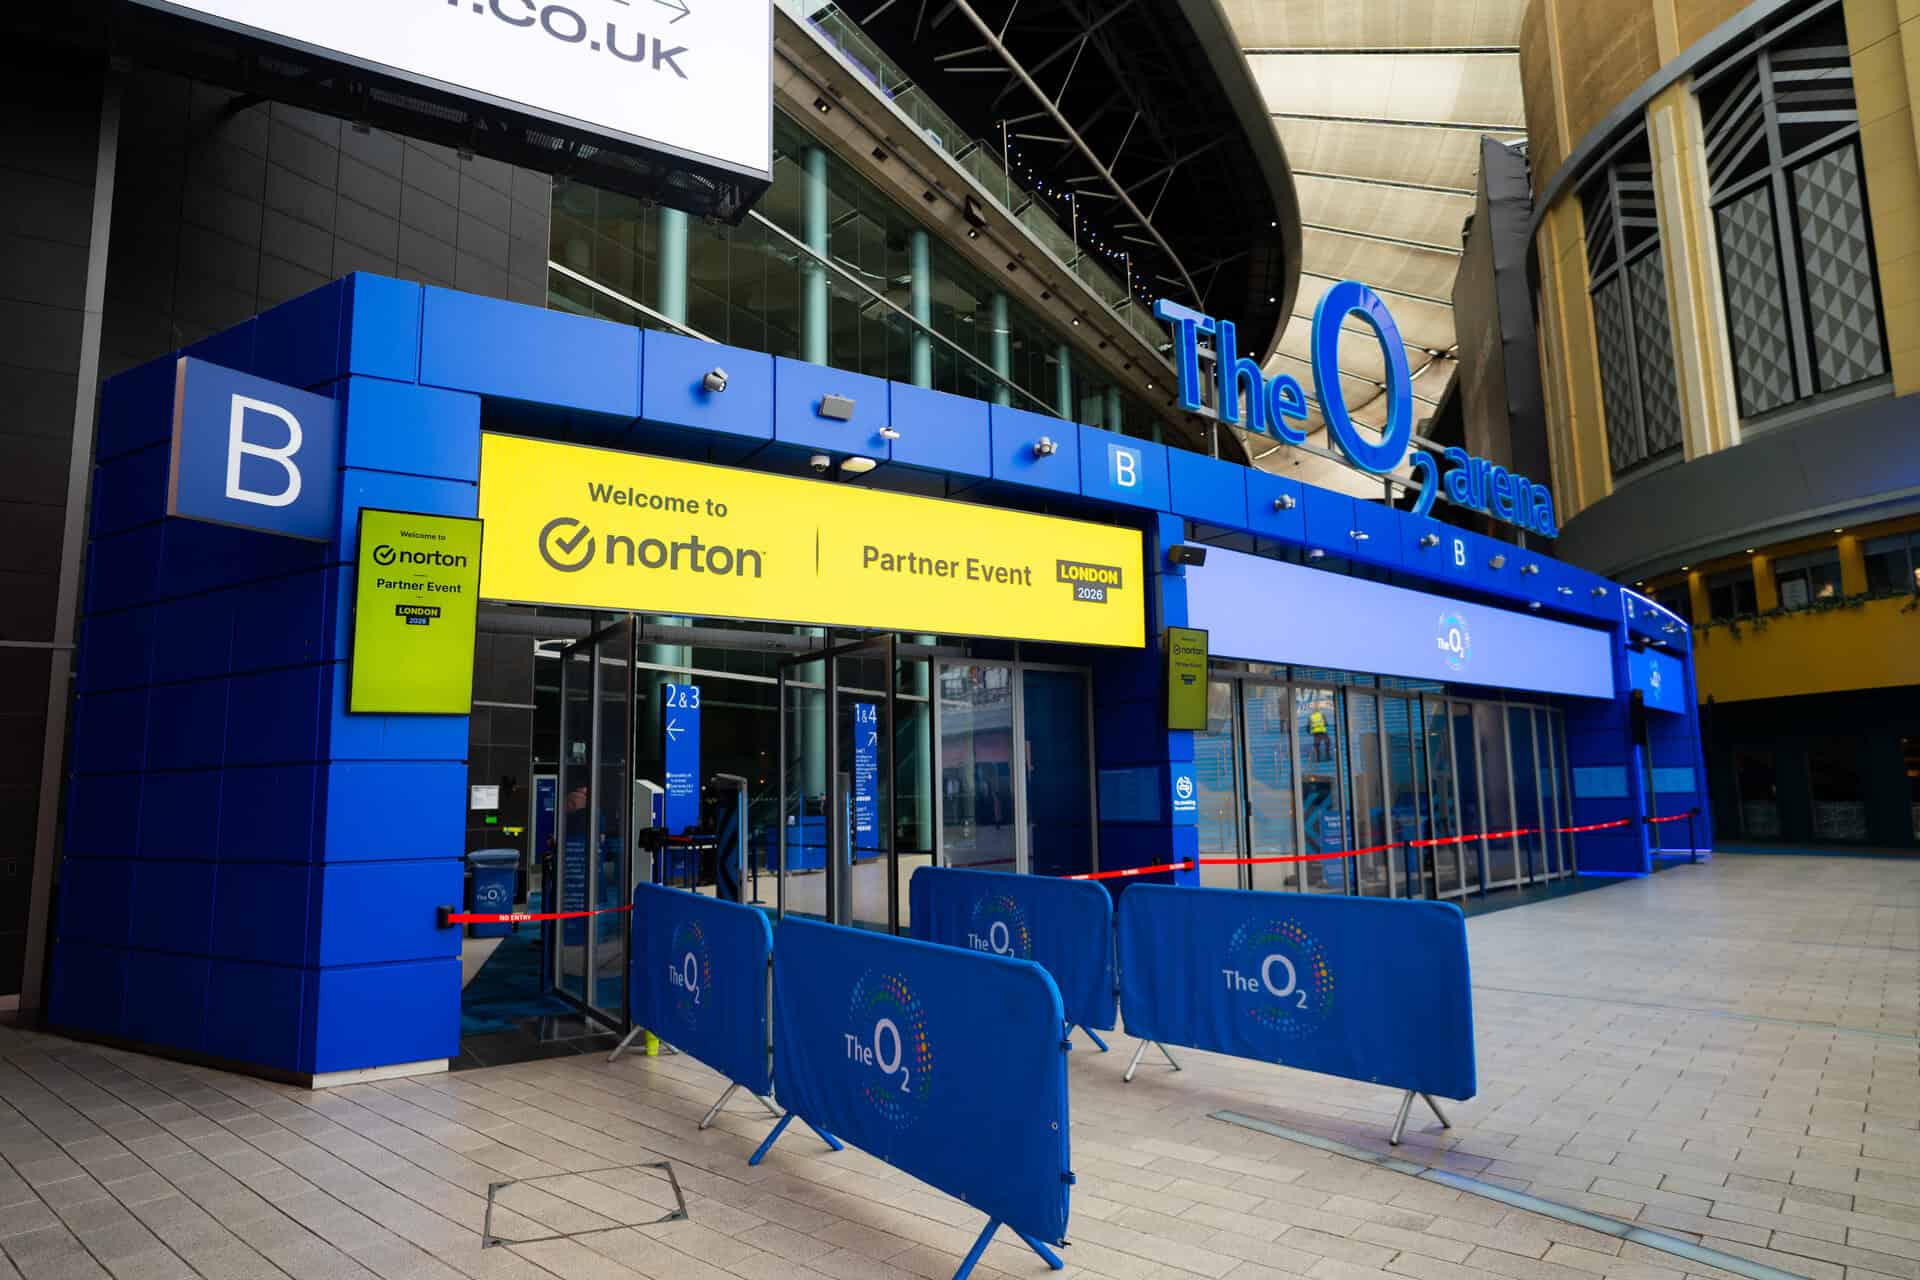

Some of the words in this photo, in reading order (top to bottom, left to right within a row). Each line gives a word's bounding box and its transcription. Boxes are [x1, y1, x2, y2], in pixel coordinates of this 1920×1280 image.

[447, 0, 689, 80] .CO.UK
[1153, 298, 1308, 446] The
[1443, 446, 1559, 538] arena
[226, 393, 303, 507] B
[1116, 450, 1137, 487] B
[588, 482, 700, 514] Welcome
[705, 498, 728, 518] to
[400, 529, 437, 540] Welcome
[399, 549, 468, 568] norton
[606, 533, 763, 578] norton
[1453, 538, 1466, 566] B
[862, 544, 960, 579] Partner
[966, 557, 1033, 587] Event
[1060, 563, 1119, 585] LONDON
[376, 578, 425, 591] Partner
[427, 582, 462, 593] Event
[1077, 586, 1104, 601] 2026
[399, 606, 439, 617] LONDON
[967, 933, 989, 951] The
[668, 964, 684, 987] The
[1222, 968, 1260, 993] The
[844, 1033, 873, 1066] The
